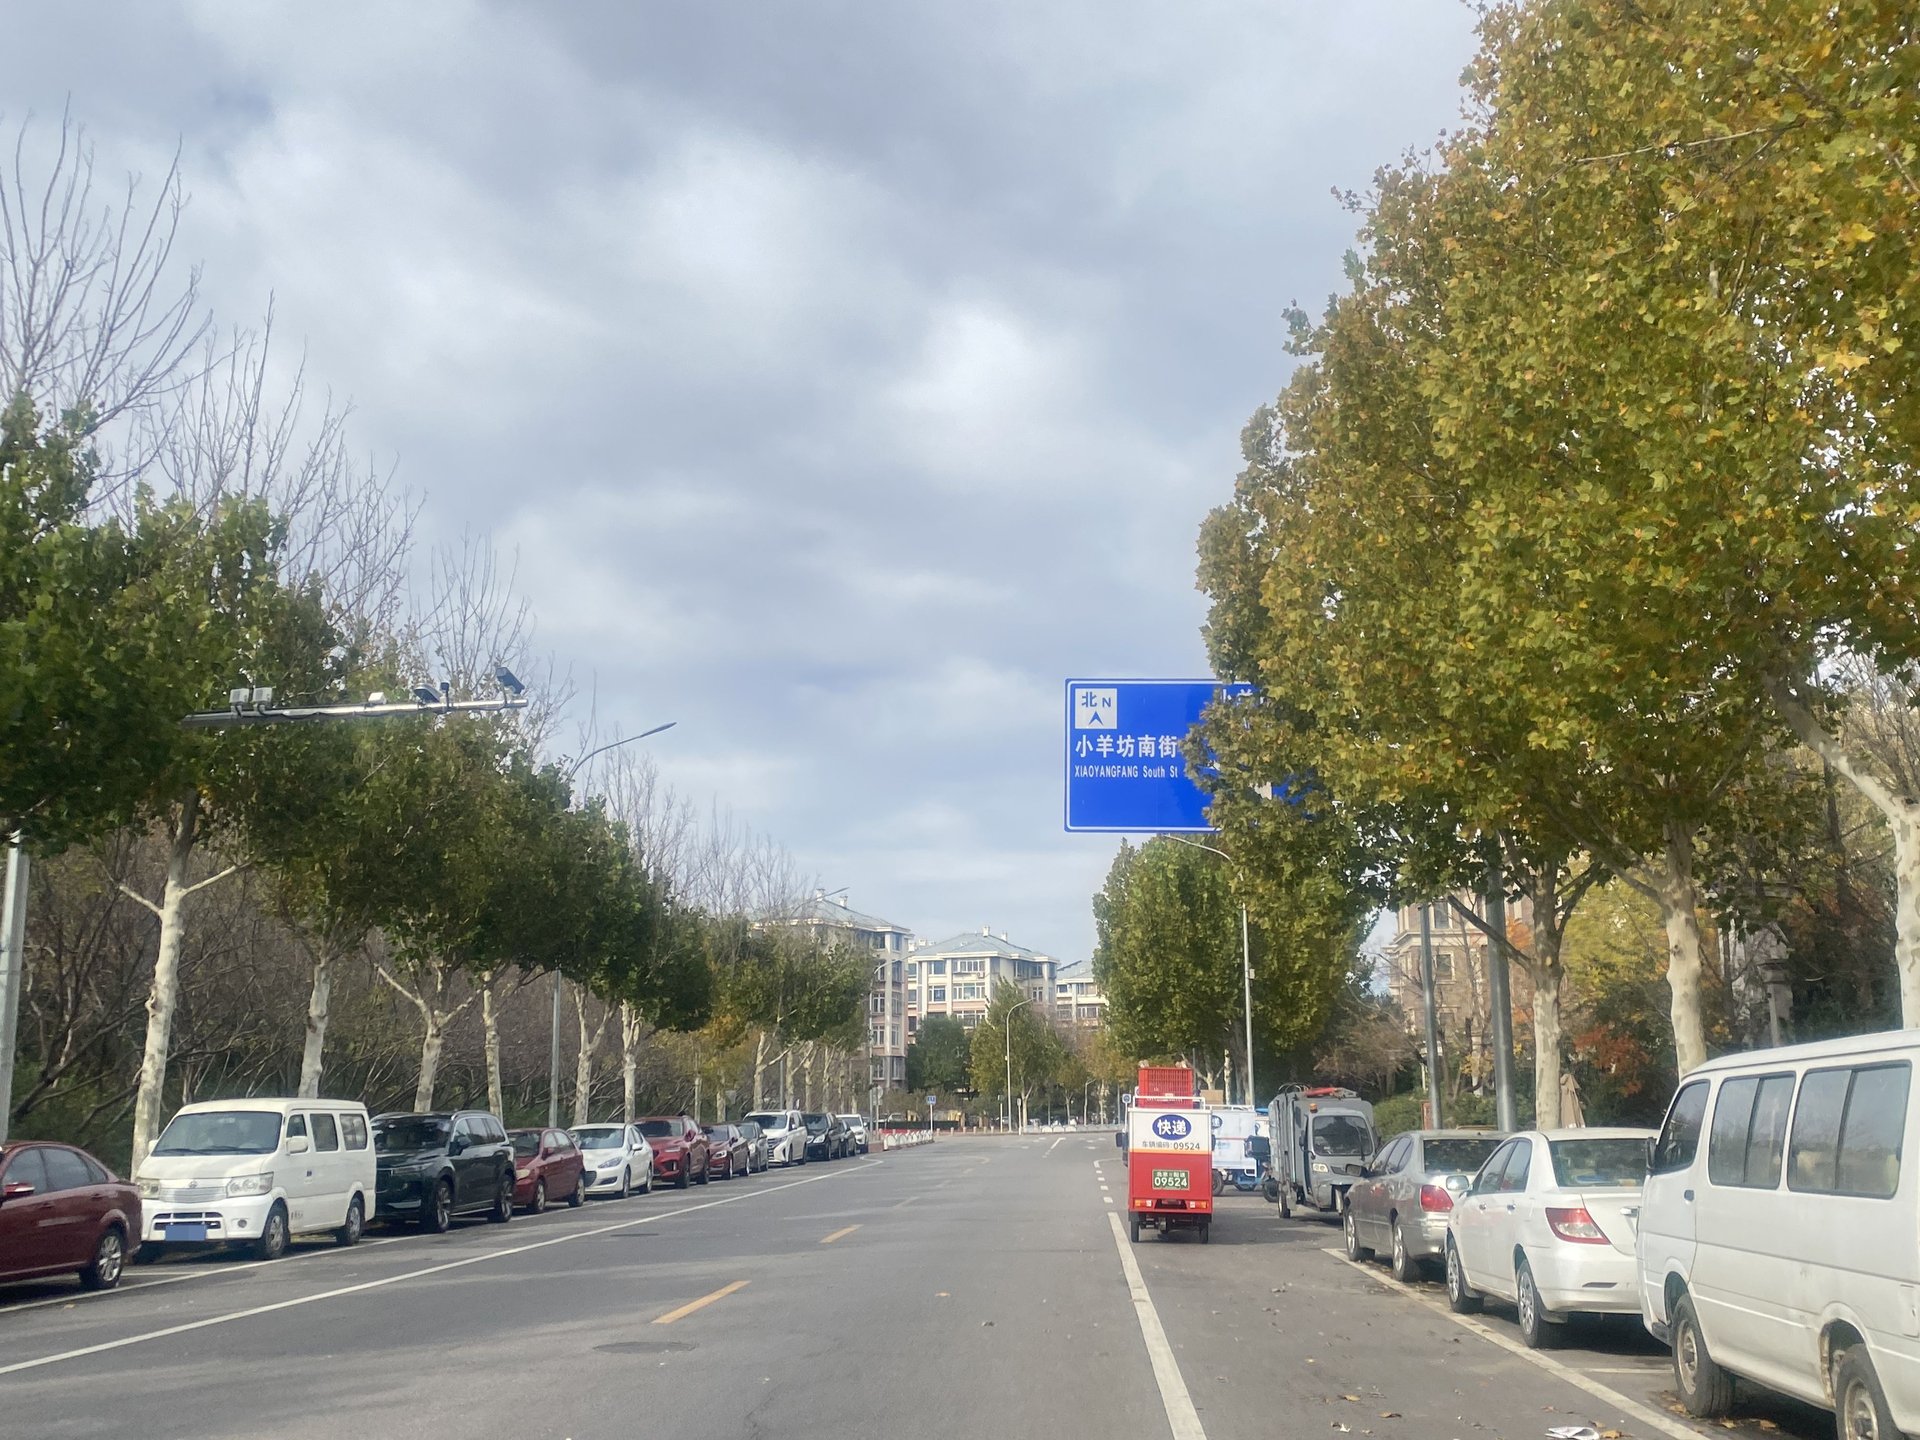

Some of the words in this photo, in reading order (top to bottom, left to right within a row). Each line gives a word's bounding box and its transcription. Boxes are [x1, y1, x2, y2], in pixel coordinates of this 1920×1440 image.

[1081, 691, 1097, 708] 北
[1102, 697, 1111, 708] N
[1075, 734, 1178, 759] 小羊坊南街
[1075, 765, 1138, 778] XIAOYANGFANG
[1143, 765, 1165, 778] South
[1170, 765, 1178, 778] St
[1157, 1119, 1187, 1136] 快递
[1154, 1177, 1188, 1187] 09524
